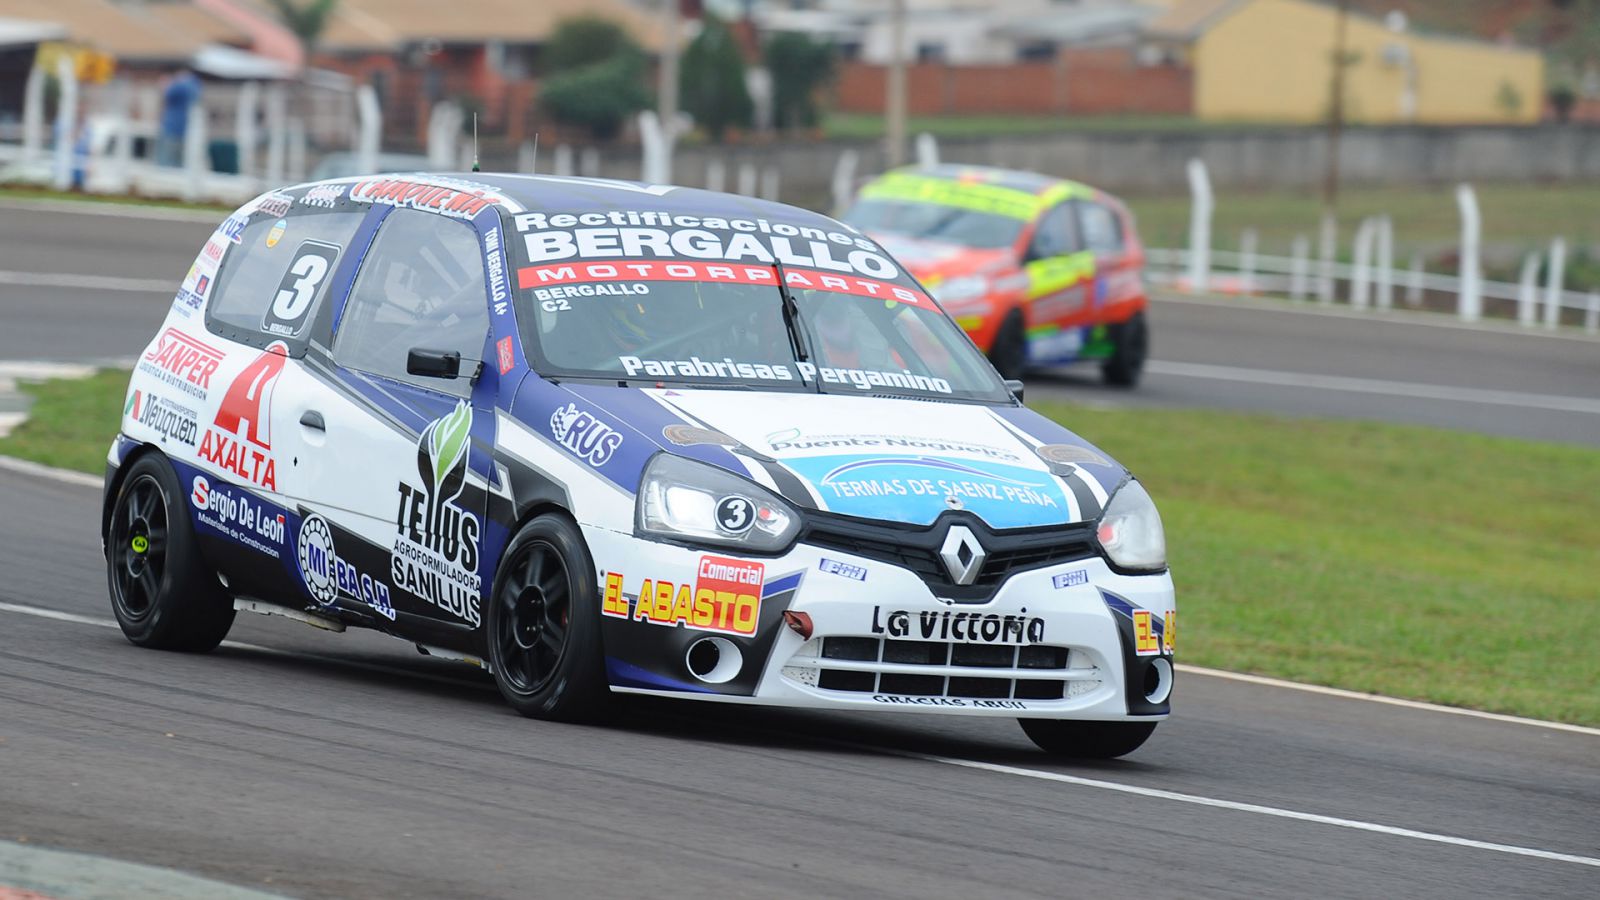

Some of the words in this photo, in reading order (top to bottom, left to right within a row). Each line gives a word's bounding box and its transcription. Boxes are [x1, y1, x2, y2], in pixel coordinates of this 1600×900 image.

[513, 211, 880, 252] Rectificaciones
[524, 227, 899, 280] BERGALLO
[272, 254, 328, 320] 3
[487, 250, 506, 301] BERGALLO
[534, 283, 650, 301] BERGALLO
[536, 264, 918, 304] MOTORPARTS
[541, 299, 572, 312] C2
[145, 328, 225, 390] SANPER
[619, 355, 792, 380] Parabrisas
[795, 361, 953, 394] Pergamino
[139, 393, 197, 446] Neuquen
[563, 413, 621, 465] RUS
[198, 430, 276, 492] AXALTA
[770, 437, 880, 452] Puente
[886, 438, 1021, 461] Nogueira
[191, 475, 237, 522] Sergio
[239, 497, 254, 530] De
[724, 498, 747, 529] 3
[829, 479, 908, 498] TERMAS
[915, 479, 938, 496] DE
[941, 480, 1004, 500] SAENZ
[1006, 484, 1057, 508] PEÑA
[198, 512, 229, 534] Materiales
[230, 528, 238, 539] de
[239, 533, 279, 558] Construccion
[393, 539, 480, 592] AGROFORMULADORA
[700, 559, 761, 586] Comercial
[603, 572, 629, 618] EL
[635, 579, 760, 635] ABASTO
[872, 605, 909, 637] La
[920, 607, 1045, 643] Victoria
[1133, 611, 1158, 652] EL
[873, 694, 966, 707] GRACIAS
